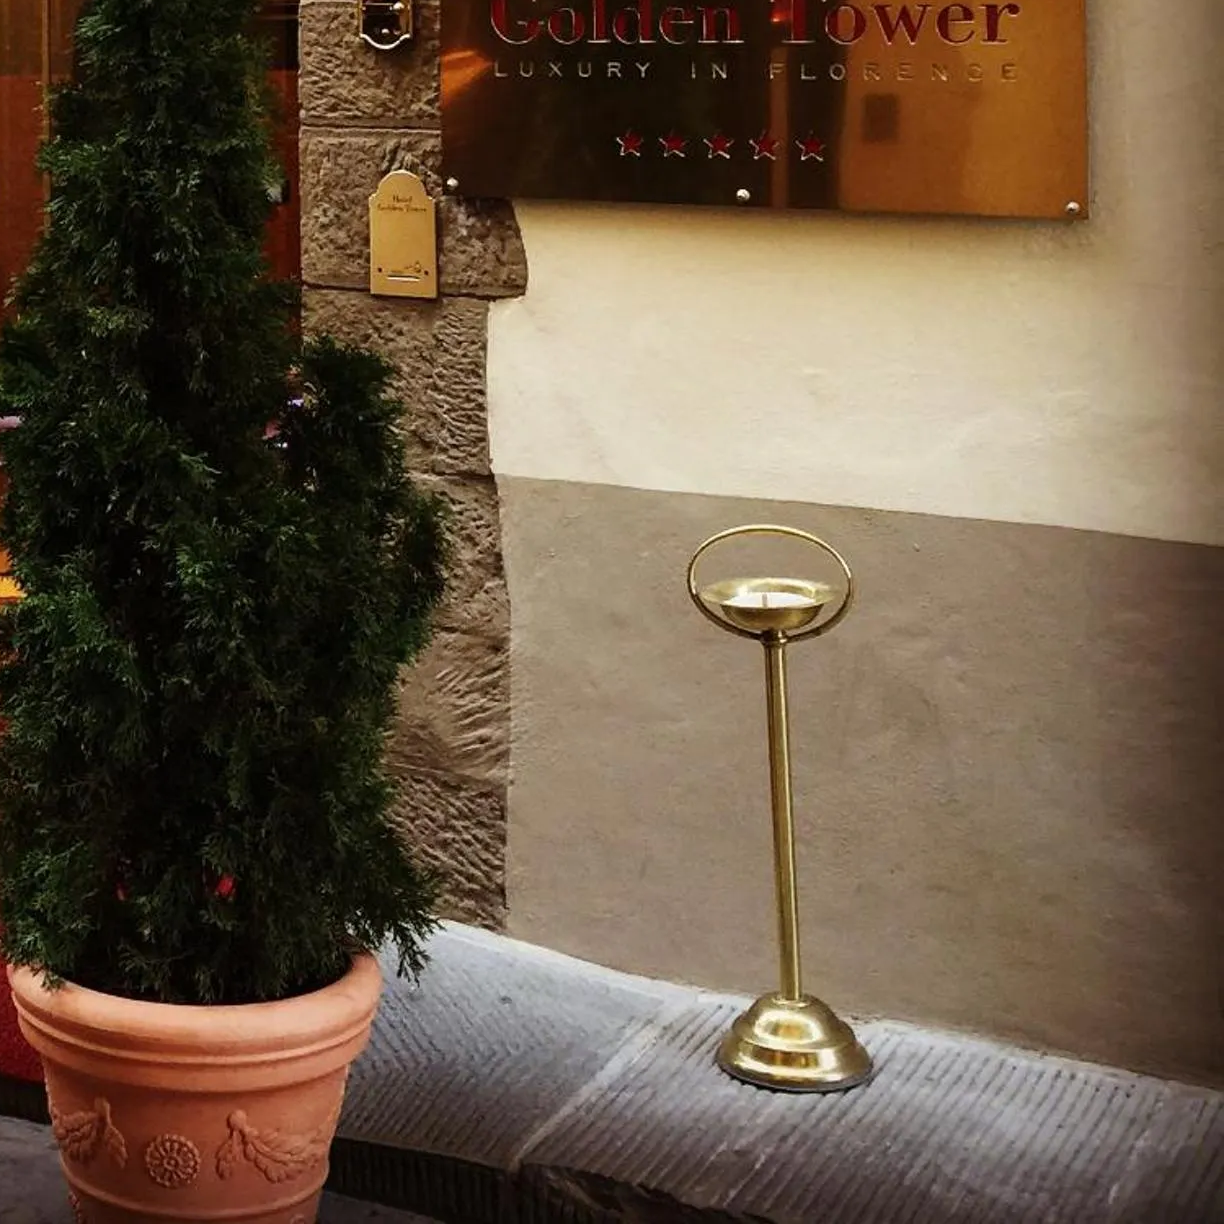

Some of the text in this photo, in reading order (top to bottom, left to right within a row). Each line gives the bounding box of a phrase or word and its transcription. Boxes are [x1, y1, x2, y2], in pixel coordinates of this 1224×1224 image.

[494, 61, 1017, 82] LUXURY IN FLORENCE
